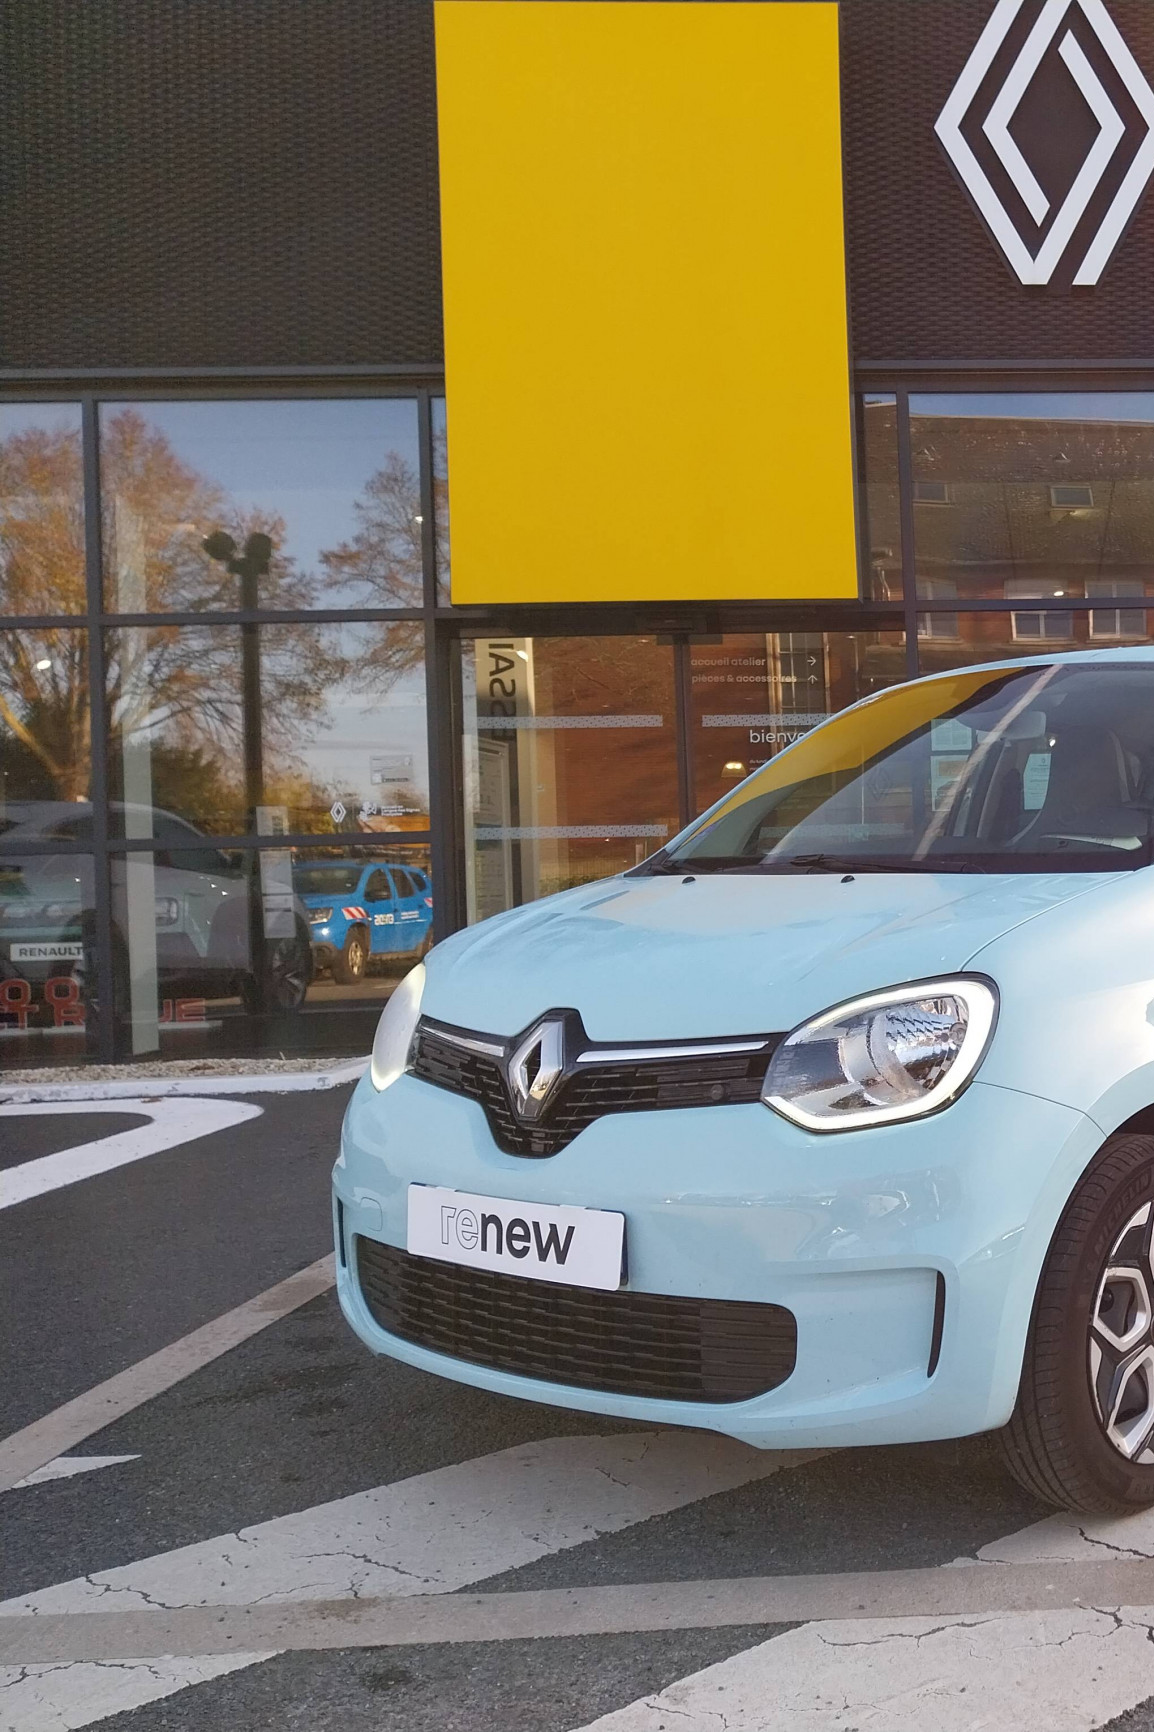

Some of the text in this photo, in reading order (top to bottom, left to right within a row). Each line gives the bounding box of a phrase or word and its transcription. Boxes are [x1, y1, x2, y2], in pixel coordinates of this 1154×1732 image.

[691, 656, 766, 666] accueil atelier
[692, 673, 797, 685] pièces & accessoires
[19, 946, 84, 957] RENAULT
[440, 1205, 576, 1266] renew
